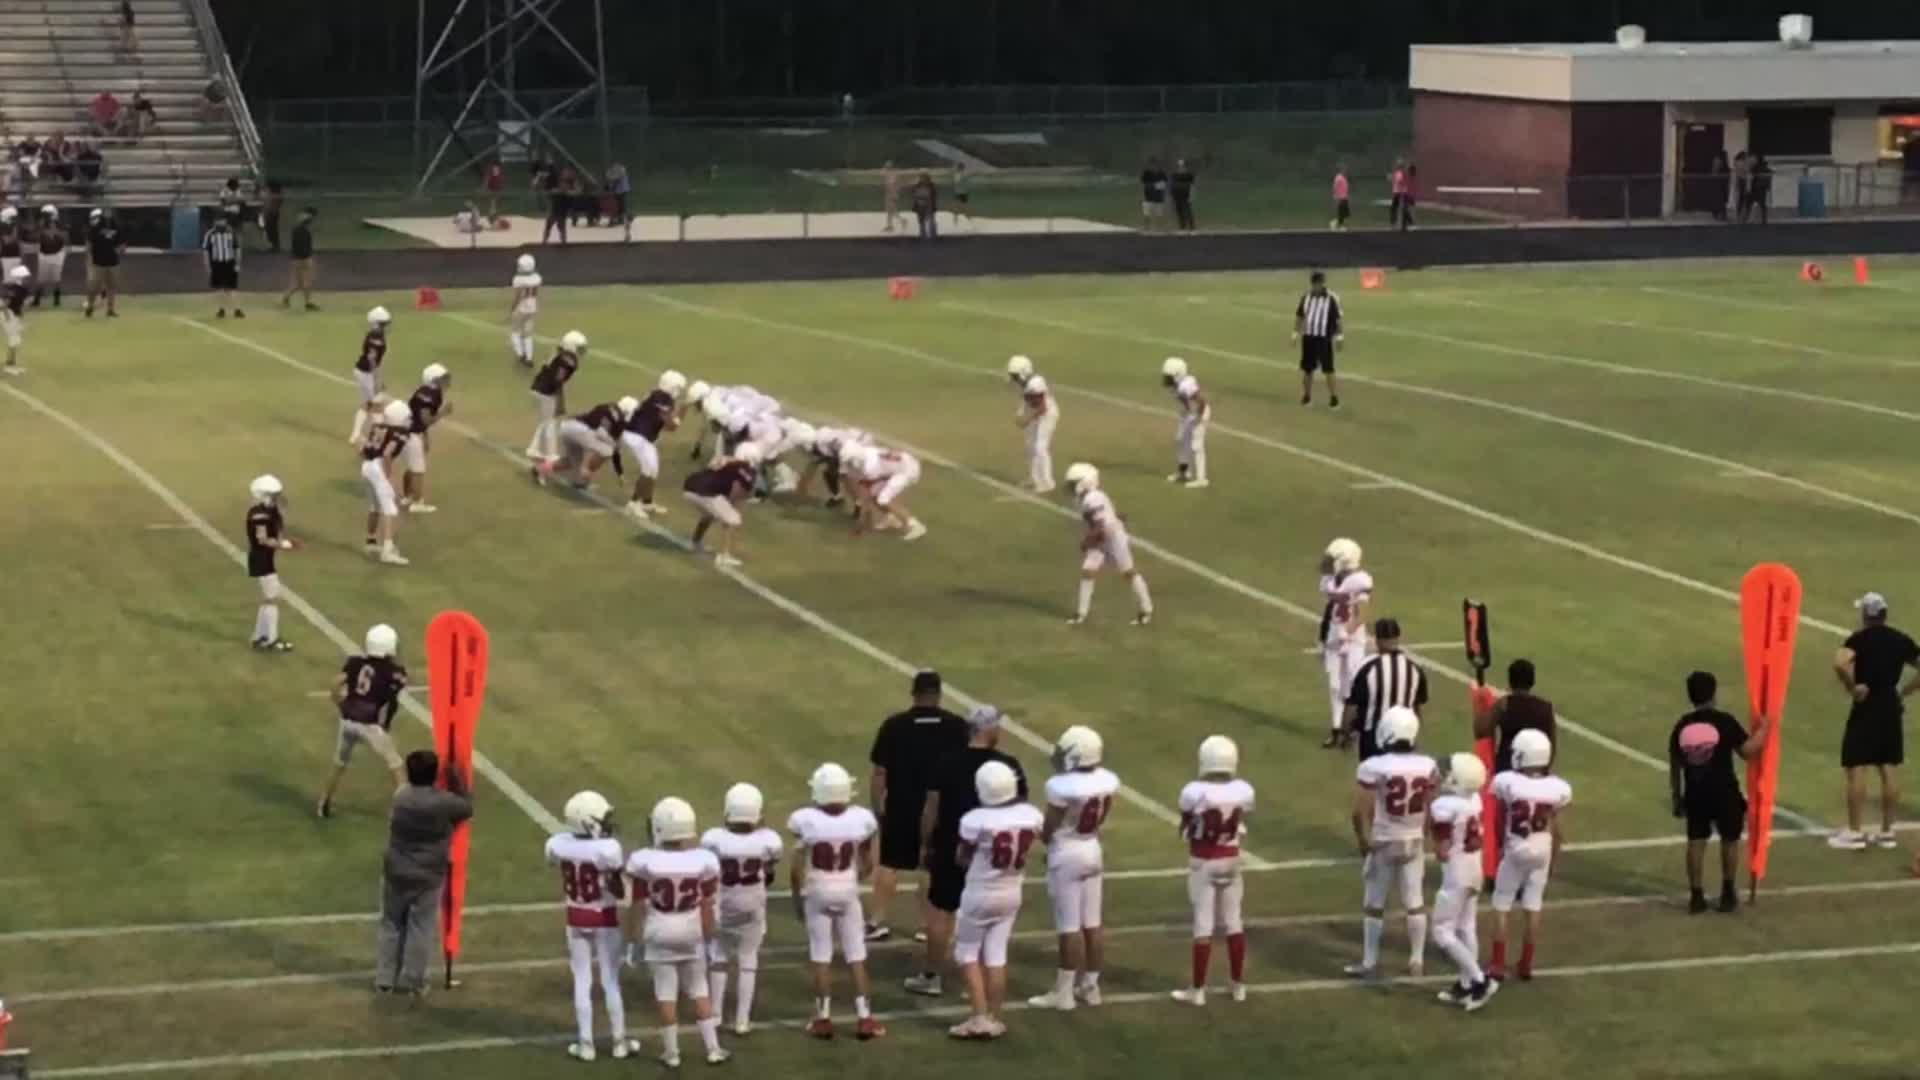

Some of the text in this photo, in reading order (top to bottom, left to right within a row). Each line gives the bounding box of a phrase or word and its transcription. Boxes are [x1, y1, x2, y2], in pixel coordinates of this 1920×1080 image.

[357, 665, 377, 696] 6
[1386, 774, 1428, 817] 22
[651, 877, 700, 914] 32
